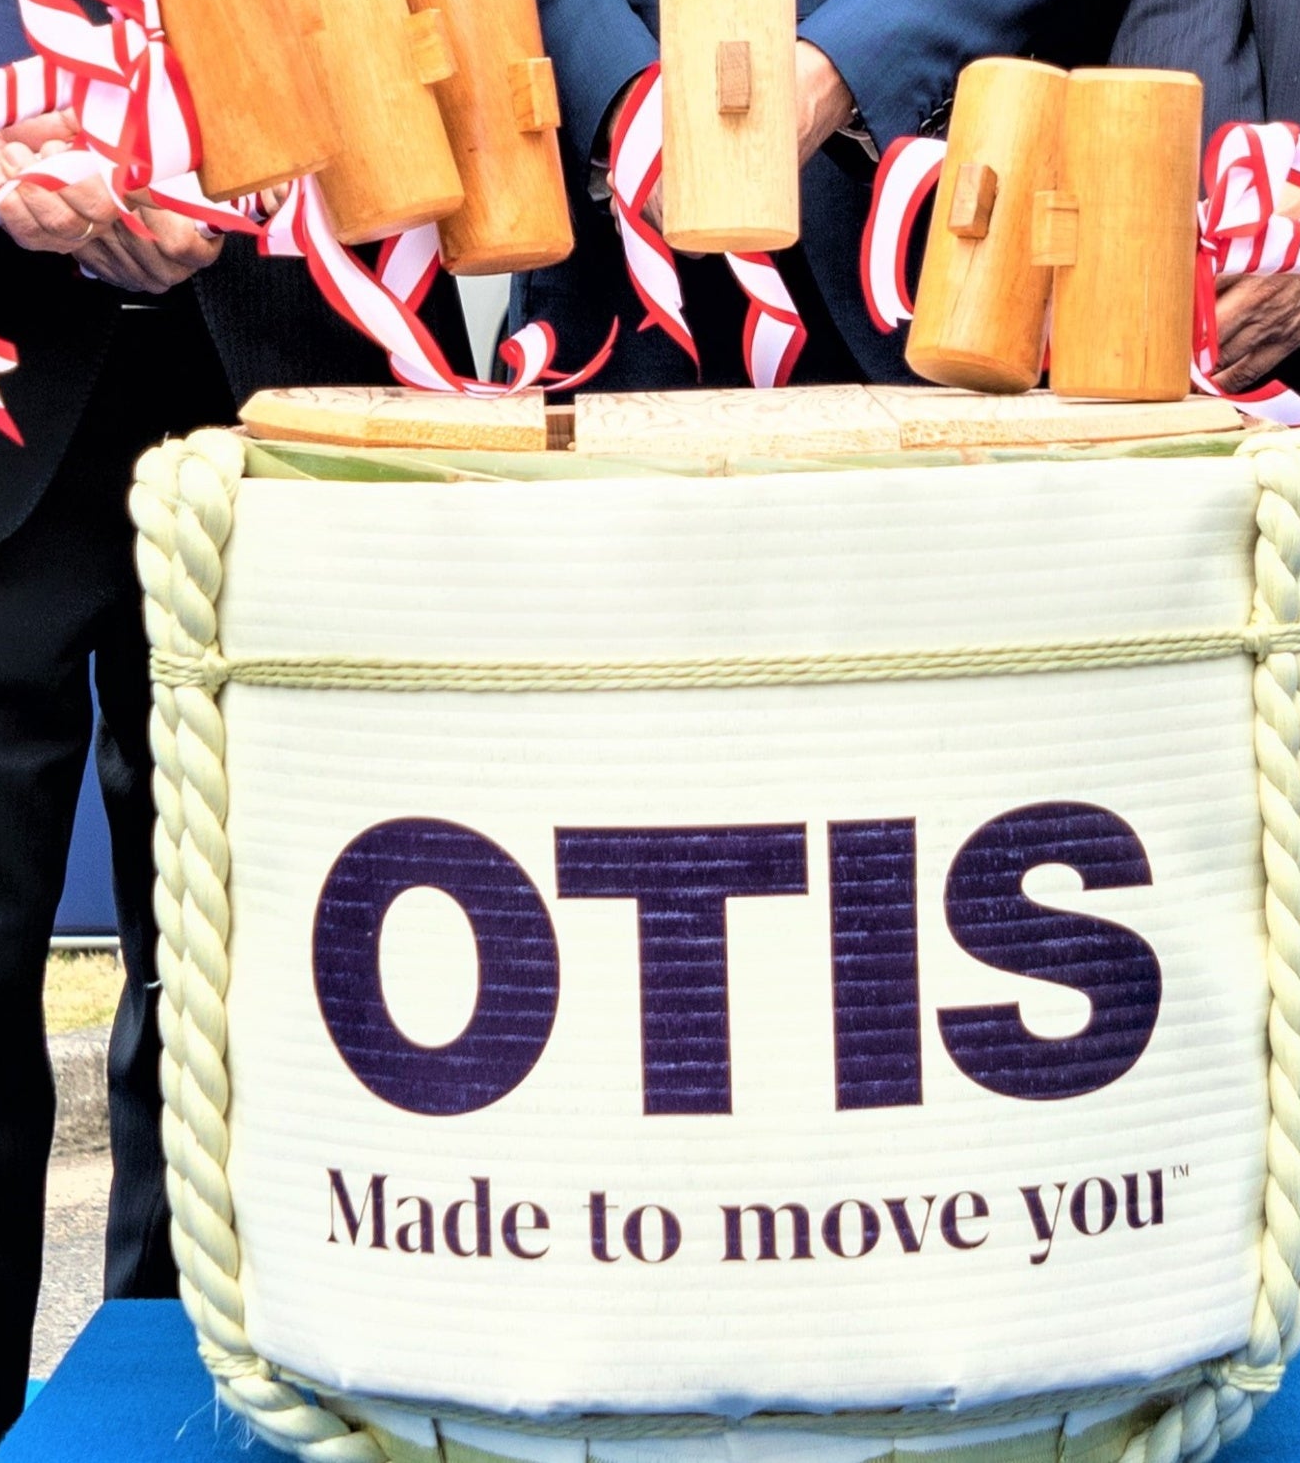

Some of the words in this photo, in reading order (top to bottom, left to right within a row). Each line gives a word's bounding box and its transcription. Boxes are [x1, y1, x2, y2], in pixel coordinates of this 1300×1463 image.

[311, 800, 1164, 1118] OTIS
[325, 1167, 551, 1260] Made
[582, 1191, 683, 1263] to
[719, 1190, 991, 1262] move
